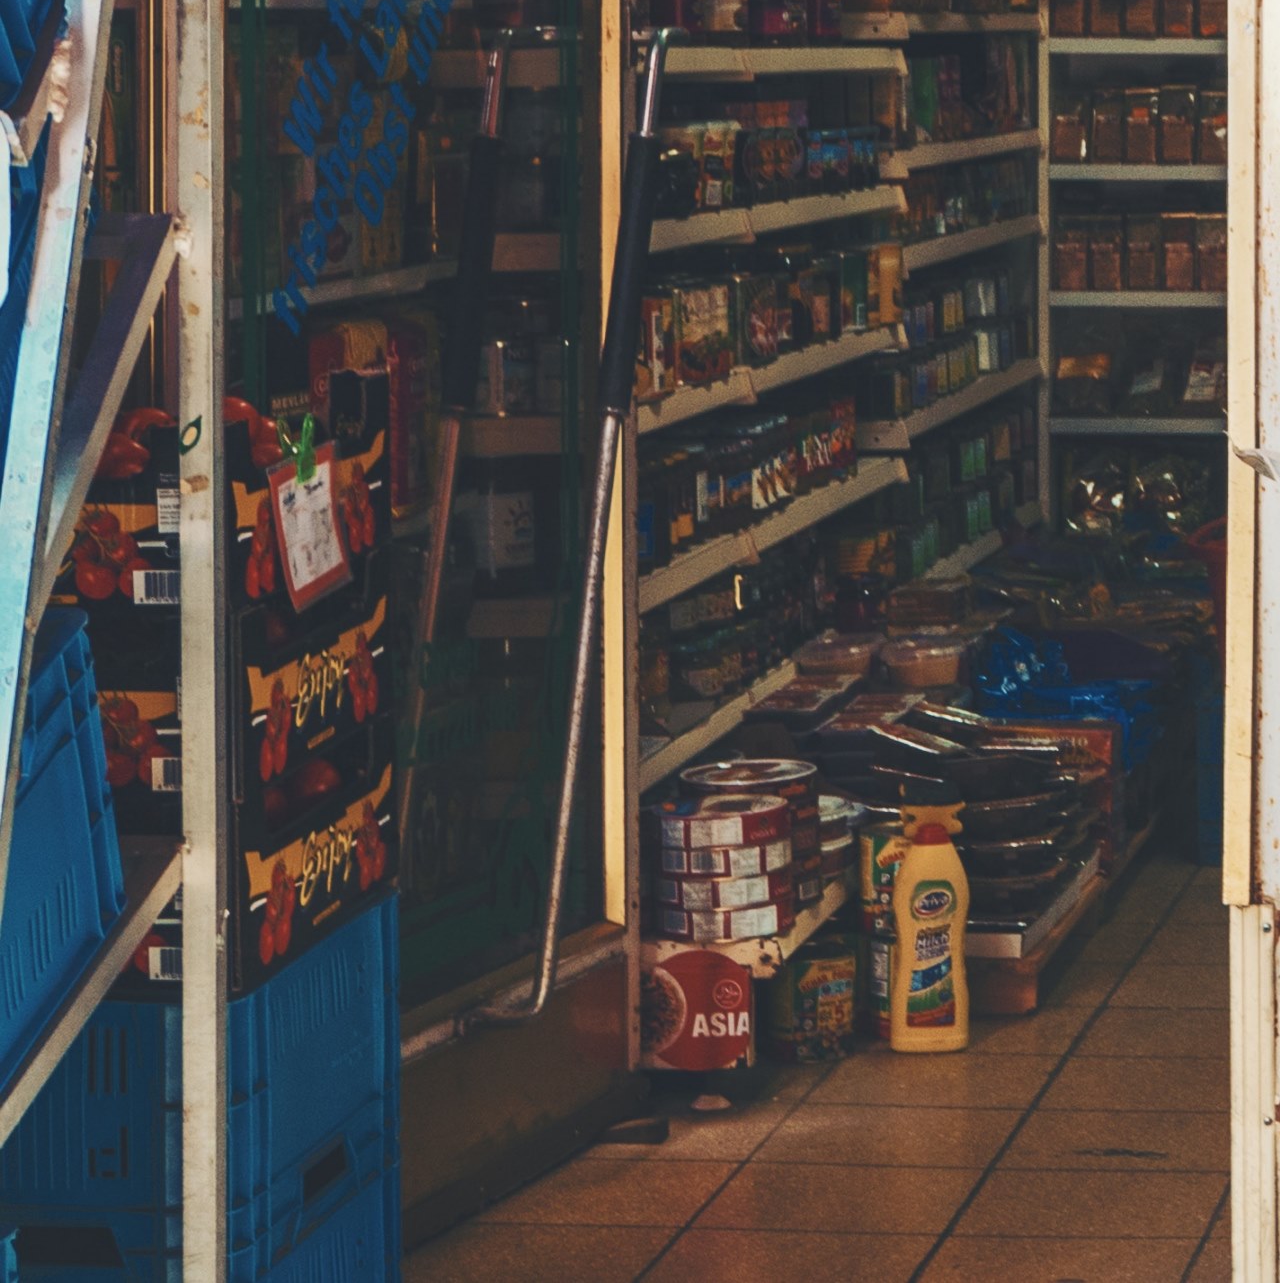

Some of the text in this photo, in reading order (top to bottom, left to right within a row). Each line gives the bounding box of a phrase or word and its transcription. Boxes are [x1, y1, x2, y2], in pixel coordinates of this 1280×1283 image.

[294, 646, 346, 729] Enjoy
[299, 822, 353, 907] Enjoy
[692, 1011, 751, 1038] ASIA
